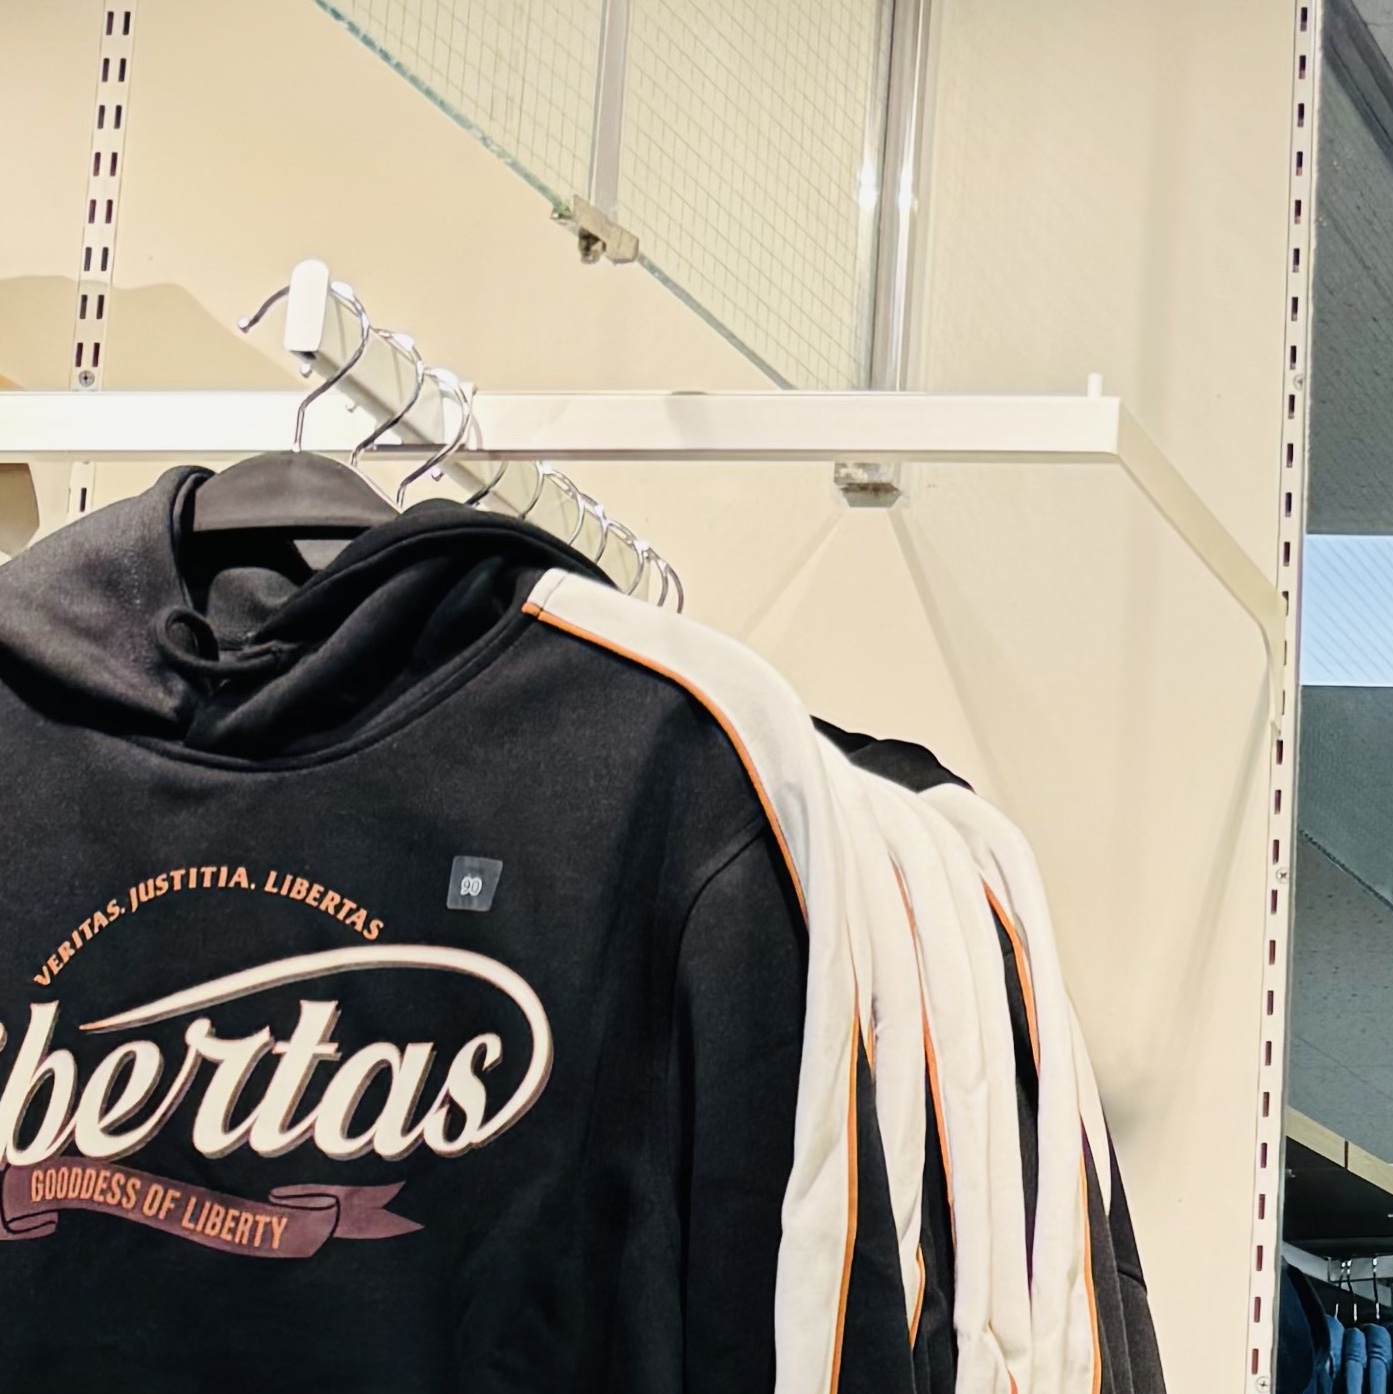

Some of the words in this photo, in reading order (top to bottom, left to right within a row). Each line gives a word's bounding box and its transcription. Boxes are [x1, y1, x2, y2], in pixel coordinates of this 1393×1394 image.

[33, 898, 126, 988] VERITAS.
[126, 866, 256, 913] JUSTITIA.
[263, 870, 385, 941] LIBERTAS
[0, 1000, 503, 1167] bertas
[142, 1184, 181, 1221] OF
[181, 1197, 288, 1250] LIBERTY
